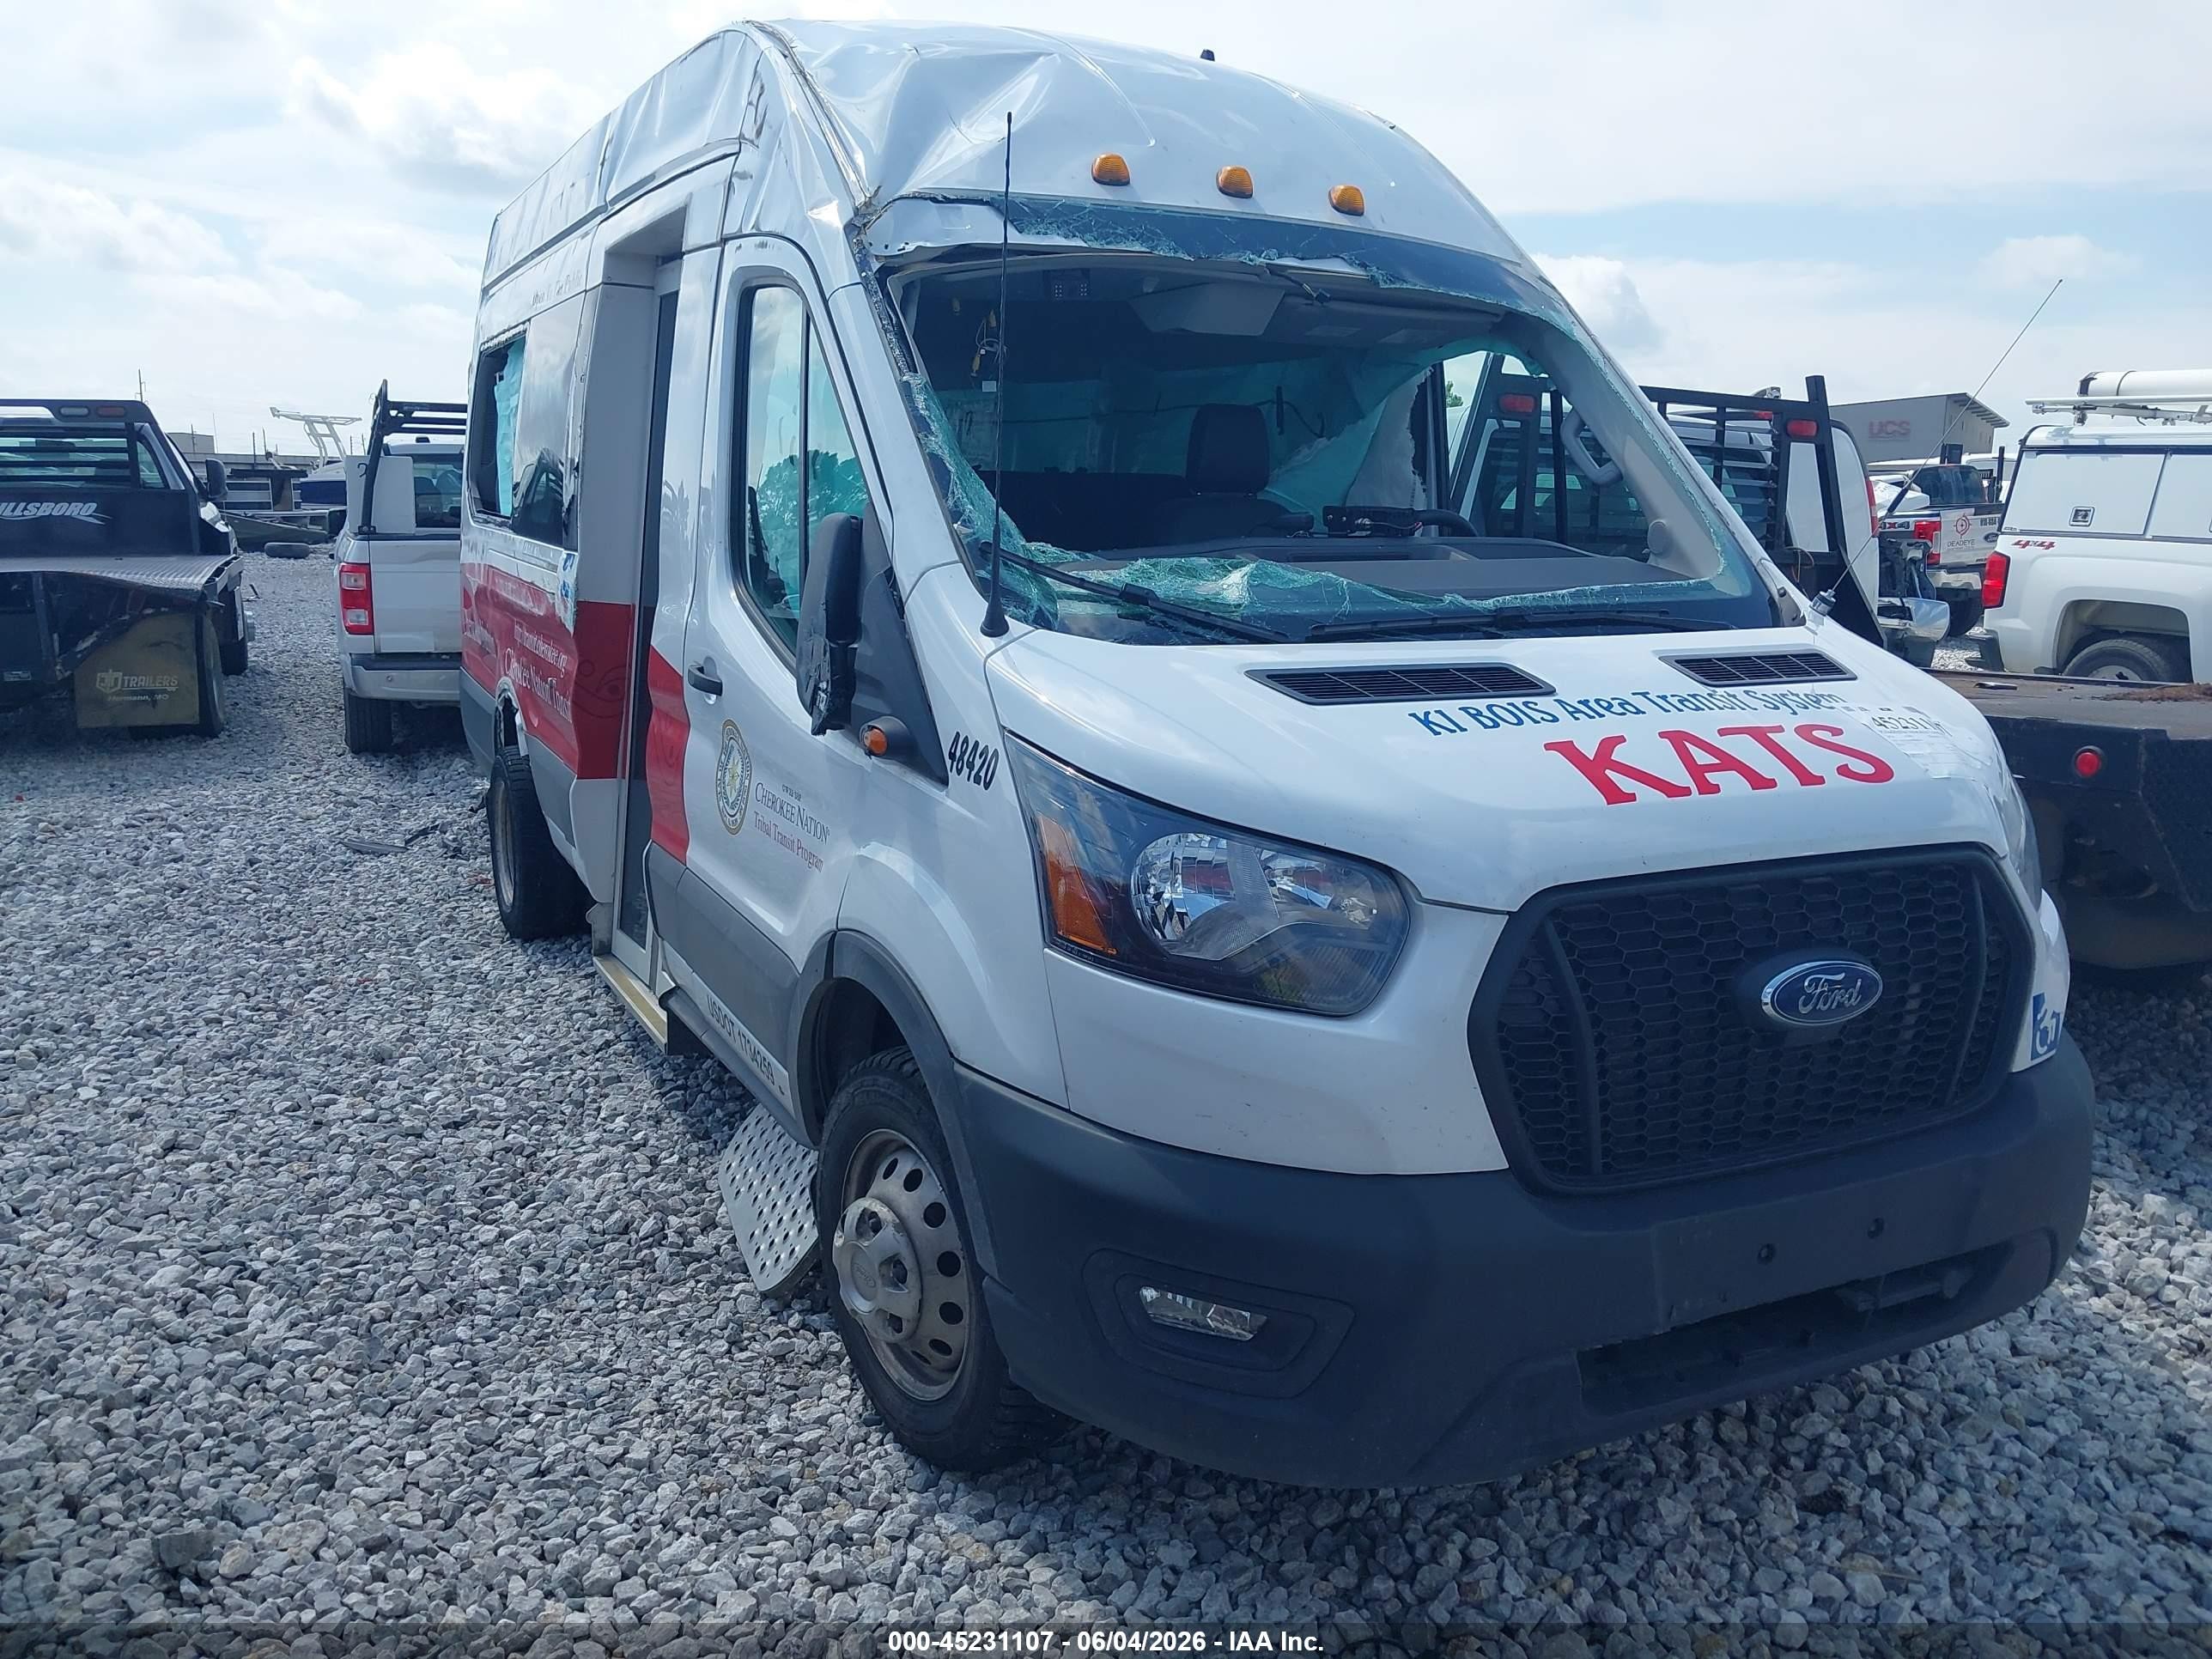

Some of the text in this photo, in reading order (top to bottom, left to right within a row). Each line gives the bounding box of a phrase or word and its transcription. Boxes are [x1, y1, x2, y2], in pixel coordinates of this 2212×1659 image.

[1869, 420, 1911, 436] UCS
[0, 501, 98, 516] ILLSBORO
[123, 675, 179, 688] TRAILERS
[1407, 689, 1848, 736] KI BOIS Area Transit System
[948, 731, 1000, 791] 48420
[1543, 723, 1894, 805] KATS
[755, 781, 796, 824] CHEROKEE
[753, 810, 823, 873] Tribal Transit Program
[1798, 972, 1863, 1014] Ford
[707, 994, 737, 1044] USDOT
